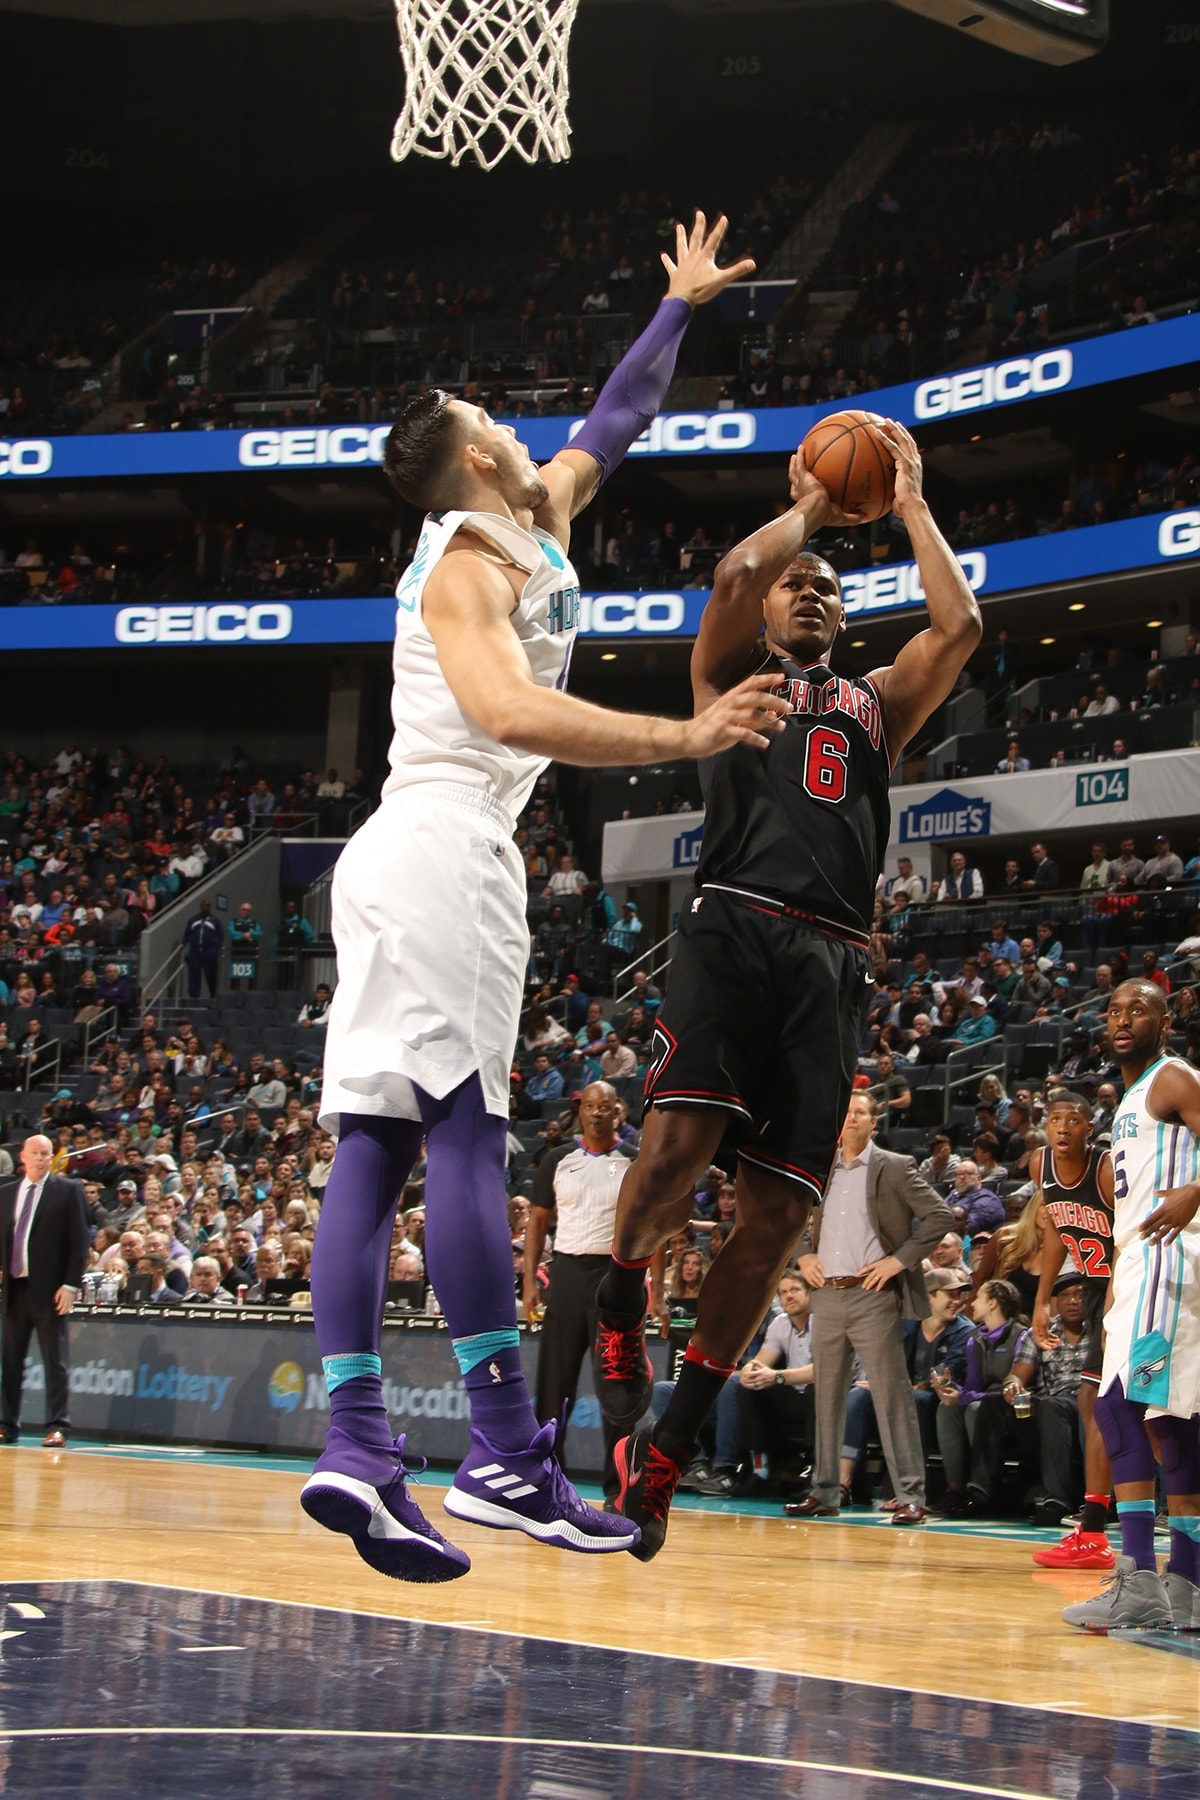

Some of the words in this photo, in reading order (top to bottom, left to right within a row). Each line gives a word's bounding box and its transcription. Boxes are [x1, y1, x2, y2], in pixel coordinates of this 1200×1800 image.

[721, 55, 761, 76] 205
[64, 147, 110, 170] 204
[914, 349, 1073, 420] GEICO
[114, 603, 293, 643] GEICO
[770, 676, 881, 751] CHICAGO
[803, 724, 850, 803] 6
[1079, 772, 1125, 804] 104
[906, 804, 984, 839] LOWE'S
[232, 963, 253, 976] 103
[135, 1362, 233, 1412] Lottery
